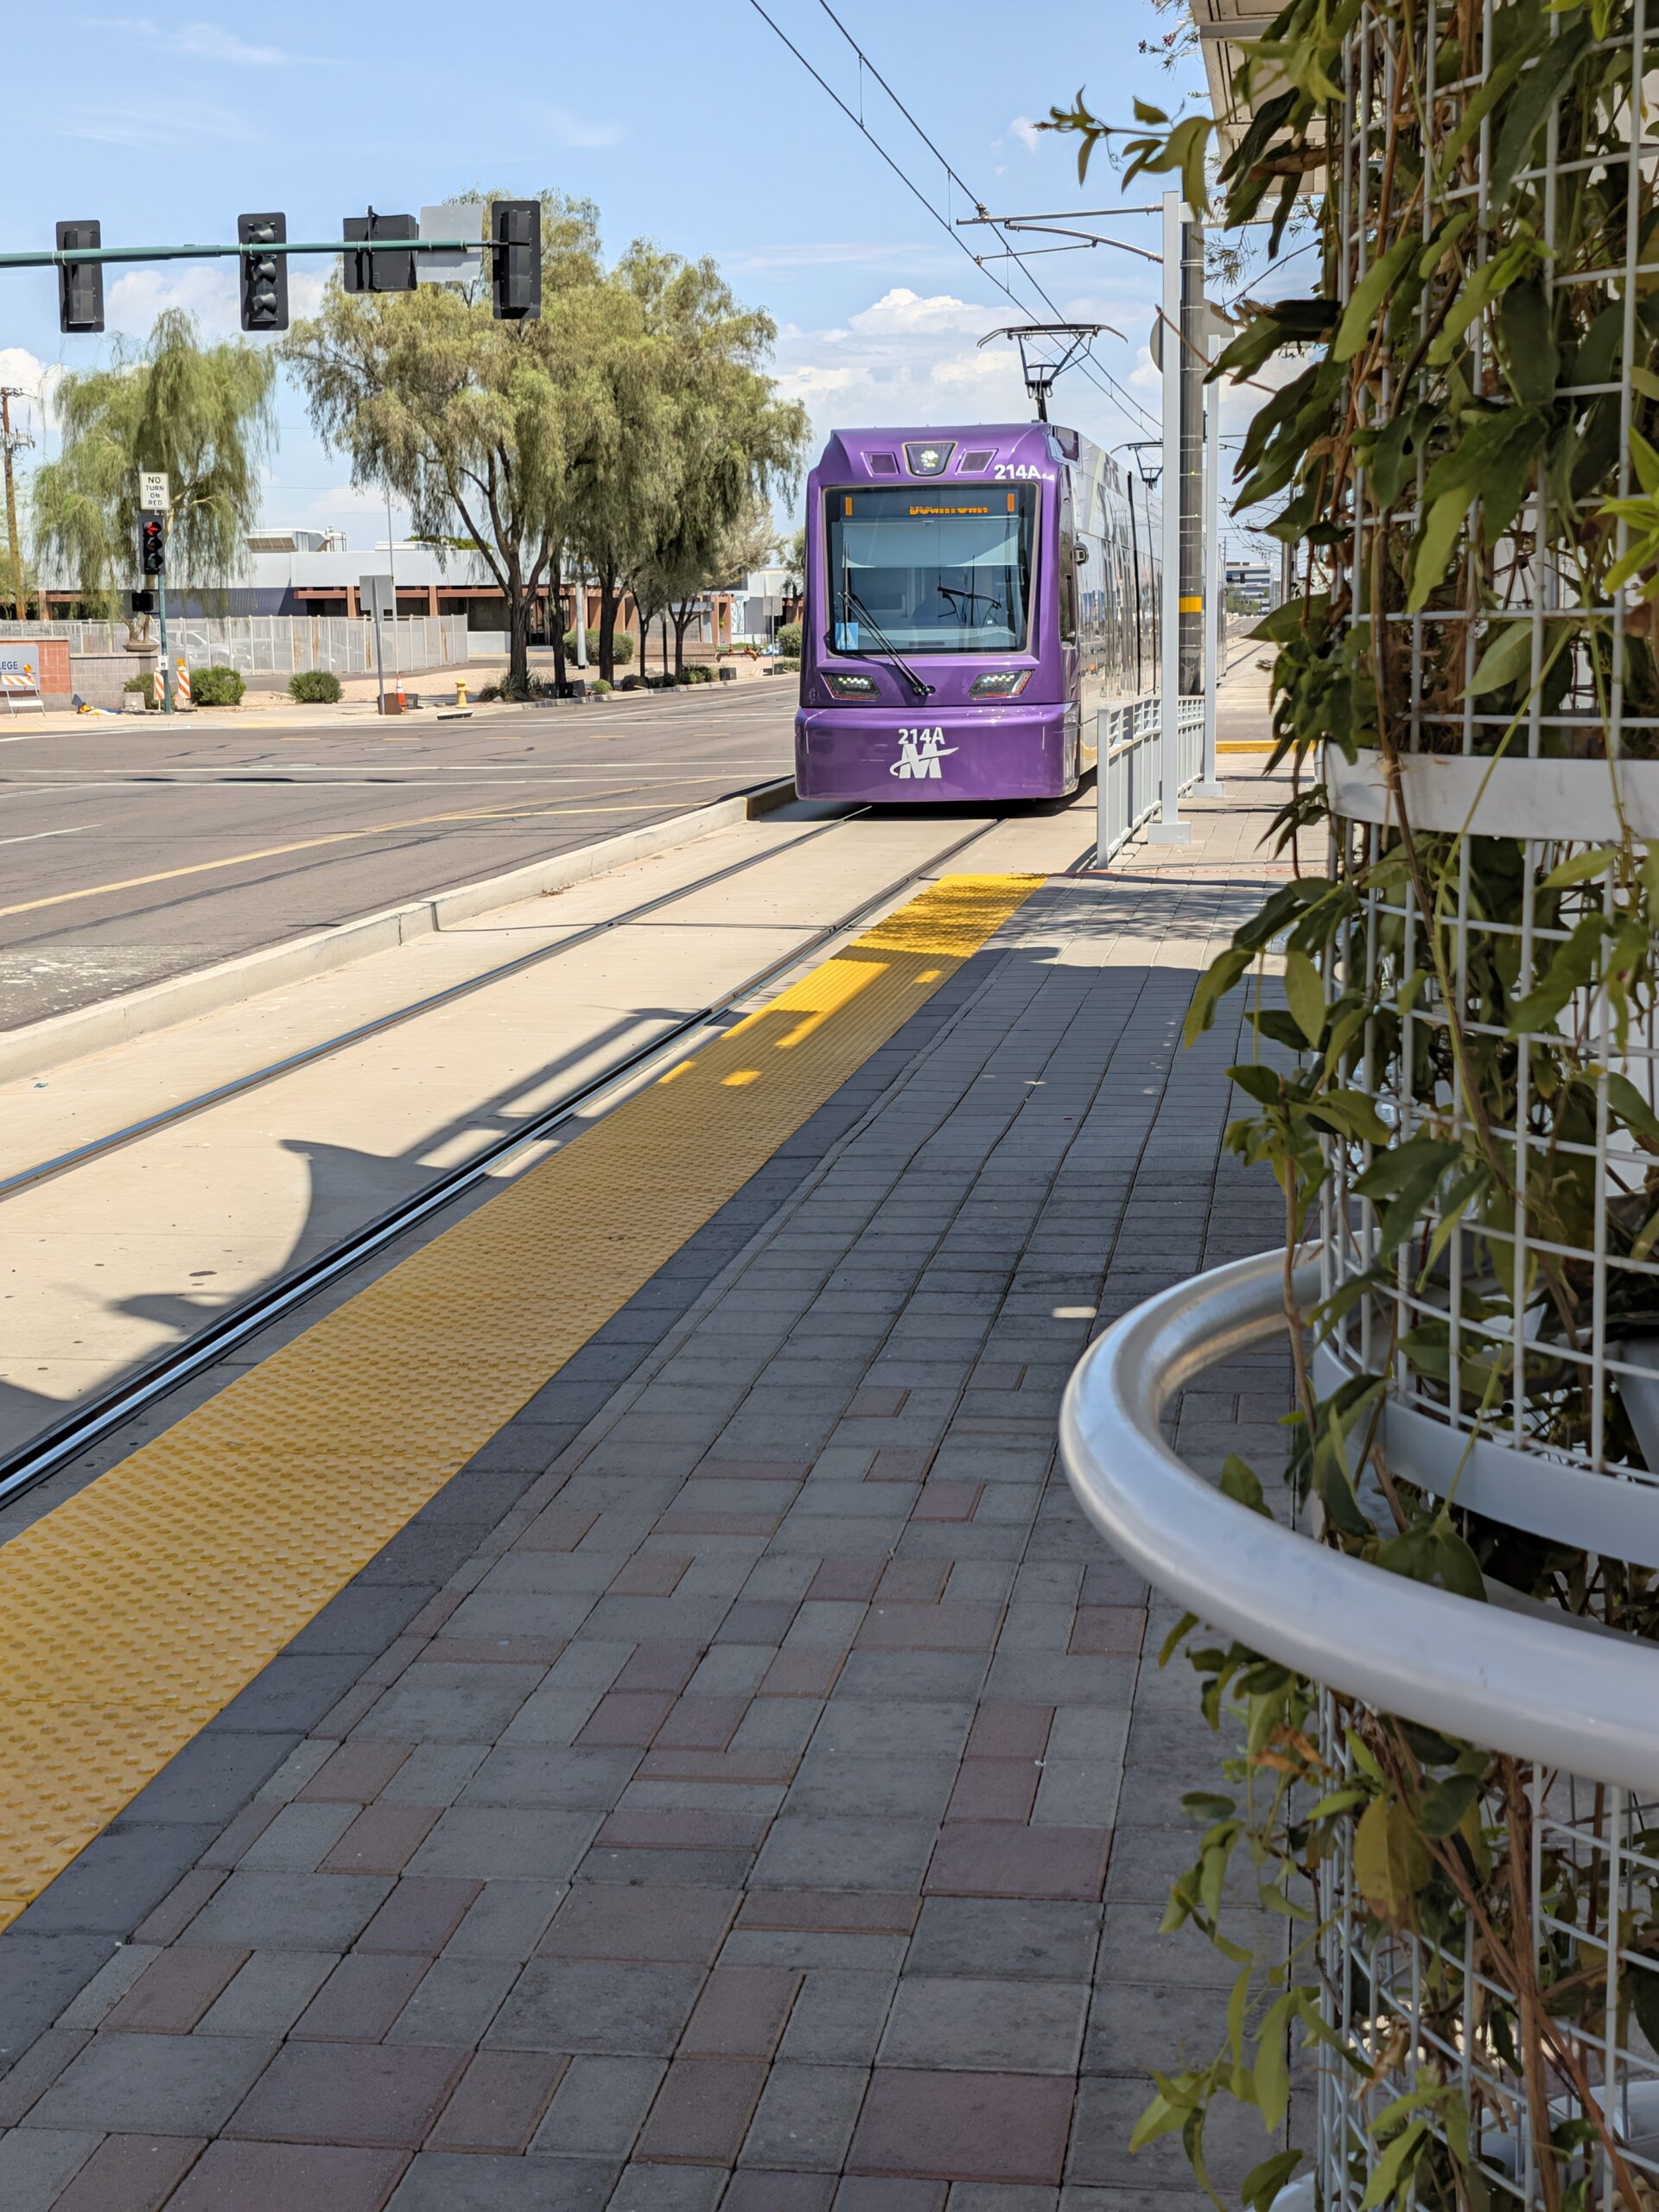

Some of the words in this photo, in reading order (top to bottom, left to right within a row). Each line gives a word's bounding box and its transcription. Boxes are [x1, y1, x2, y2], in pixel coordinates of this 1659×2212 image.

[994, 463, 1042, 480] 214A
[0, 661, 18, 670] EGE
[898, 727, 945, 744] 214A
